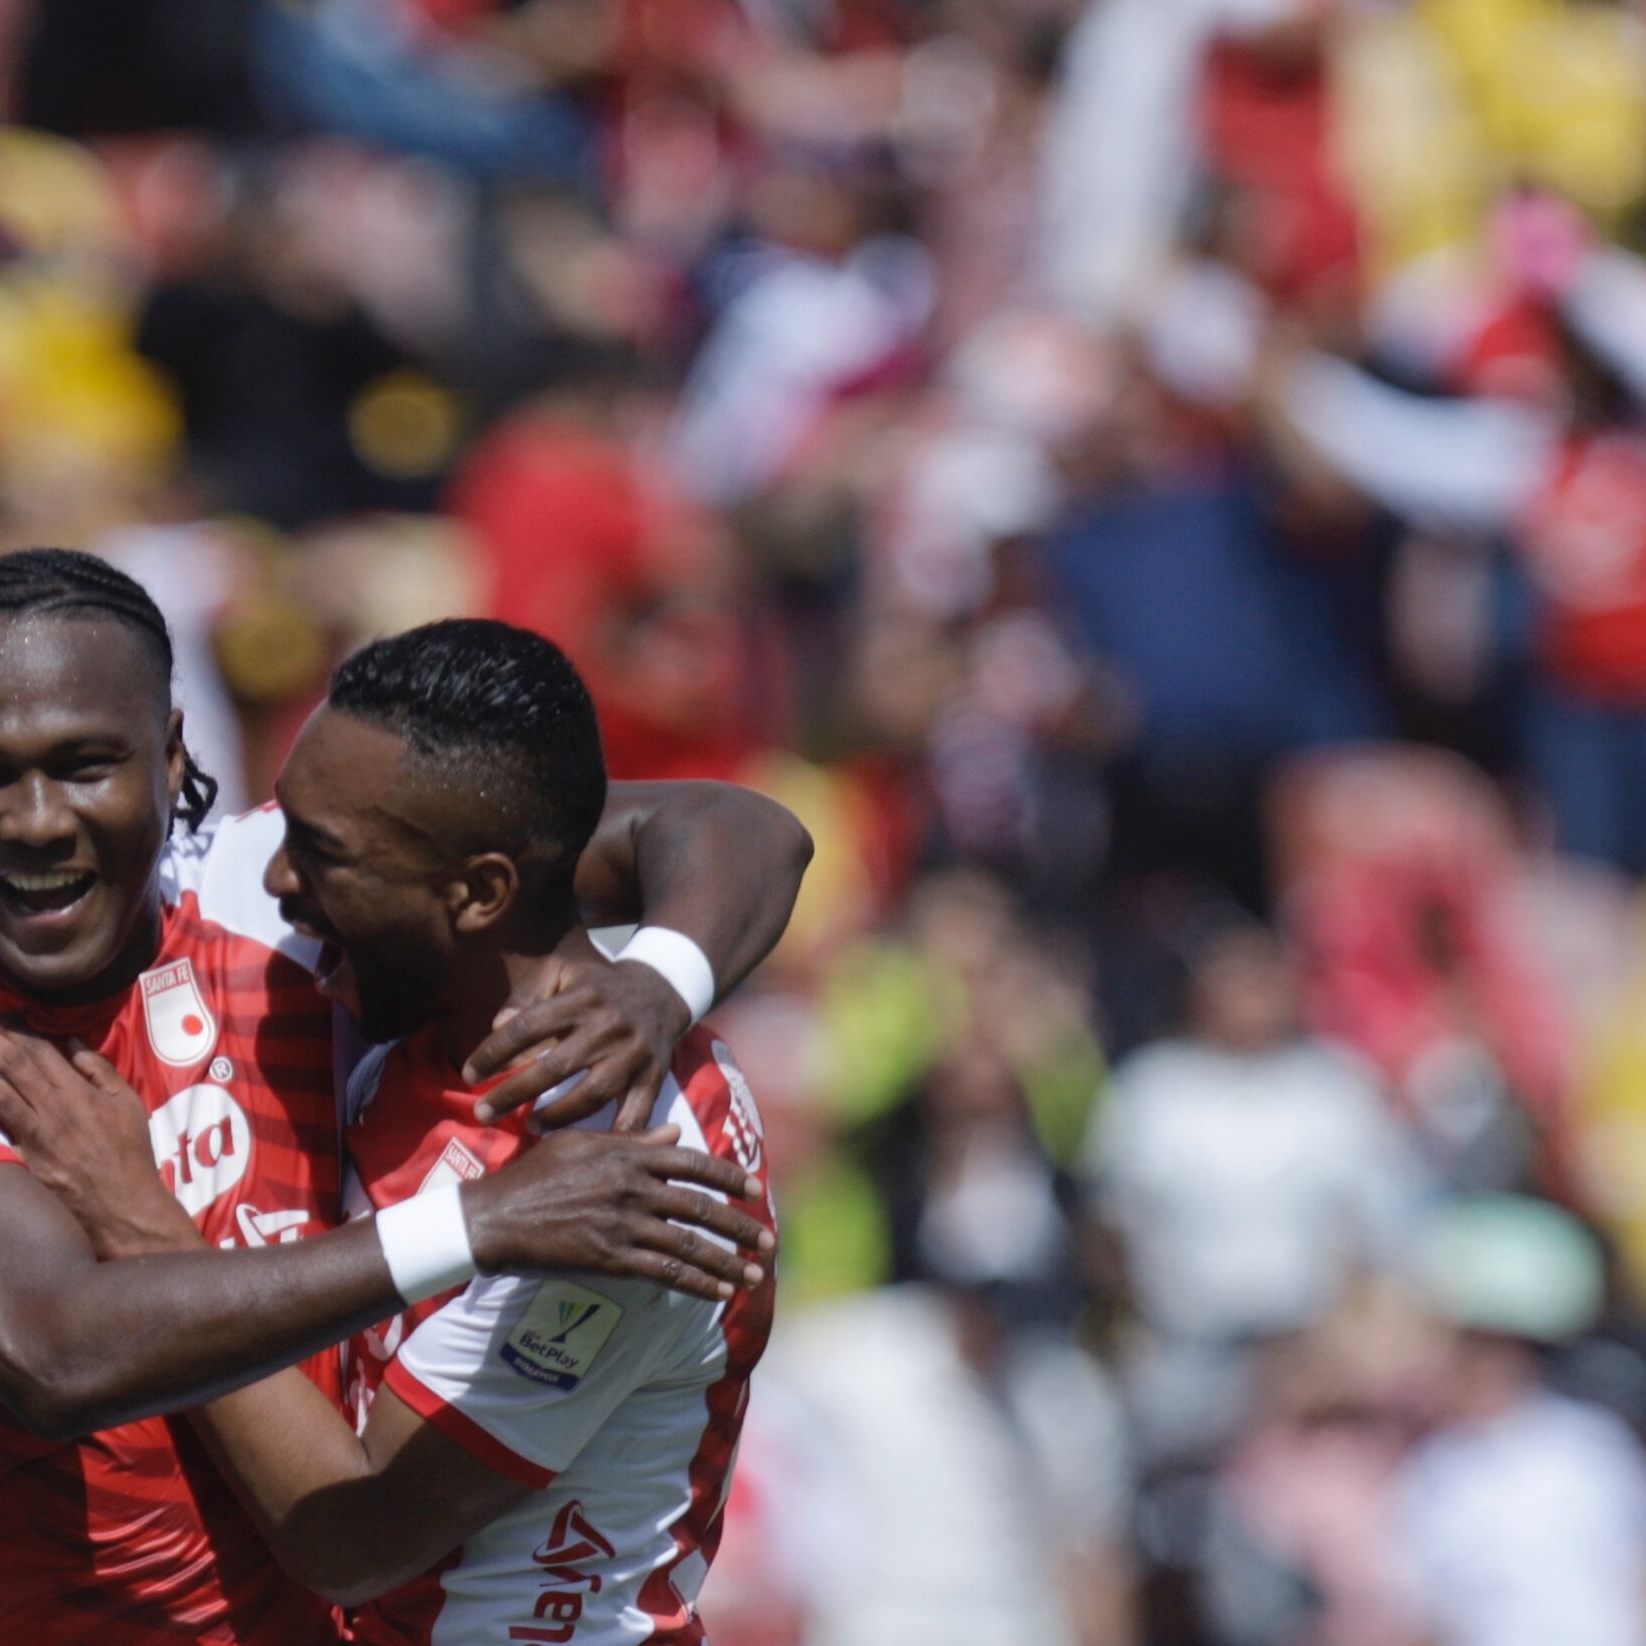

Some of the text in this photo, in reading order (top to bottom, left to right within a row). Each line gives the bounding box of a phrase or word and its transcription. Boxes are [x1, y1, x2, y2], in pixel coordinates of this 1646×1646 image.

[145, 964, 190, 996] SANTA FE
[444, 1145, 470, 1177] SANTA
[519, 1333, 580, 1369] BetPlay
